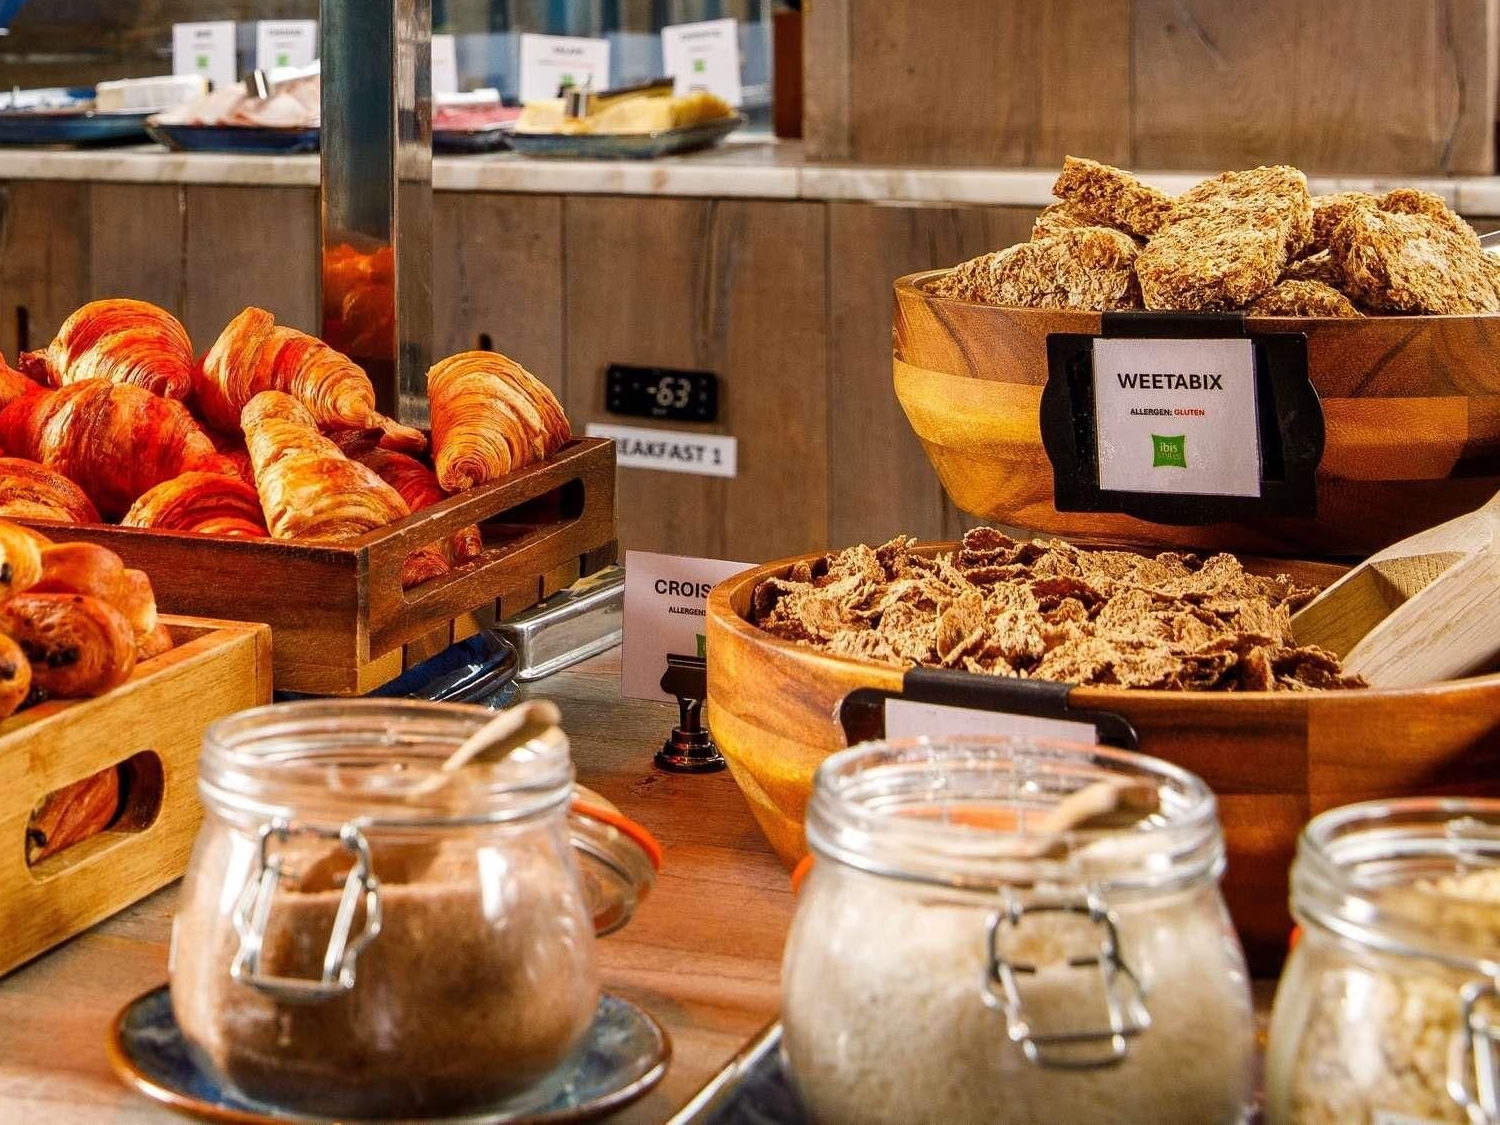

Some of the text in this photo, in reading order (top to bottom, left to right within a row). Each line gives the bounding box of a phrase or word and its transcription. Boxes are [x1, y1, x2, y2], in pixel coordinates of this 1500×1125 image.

[1116, 373, 1223, 390] WEETABIX
[1130, 408, 1205, 416] ALLERGEN: GLUTEN
[618, 436, 722, 465] EAKFAST 1
[1159, 442, 1178, 453] ibis
[654, 579, 716, 599] CROIS
